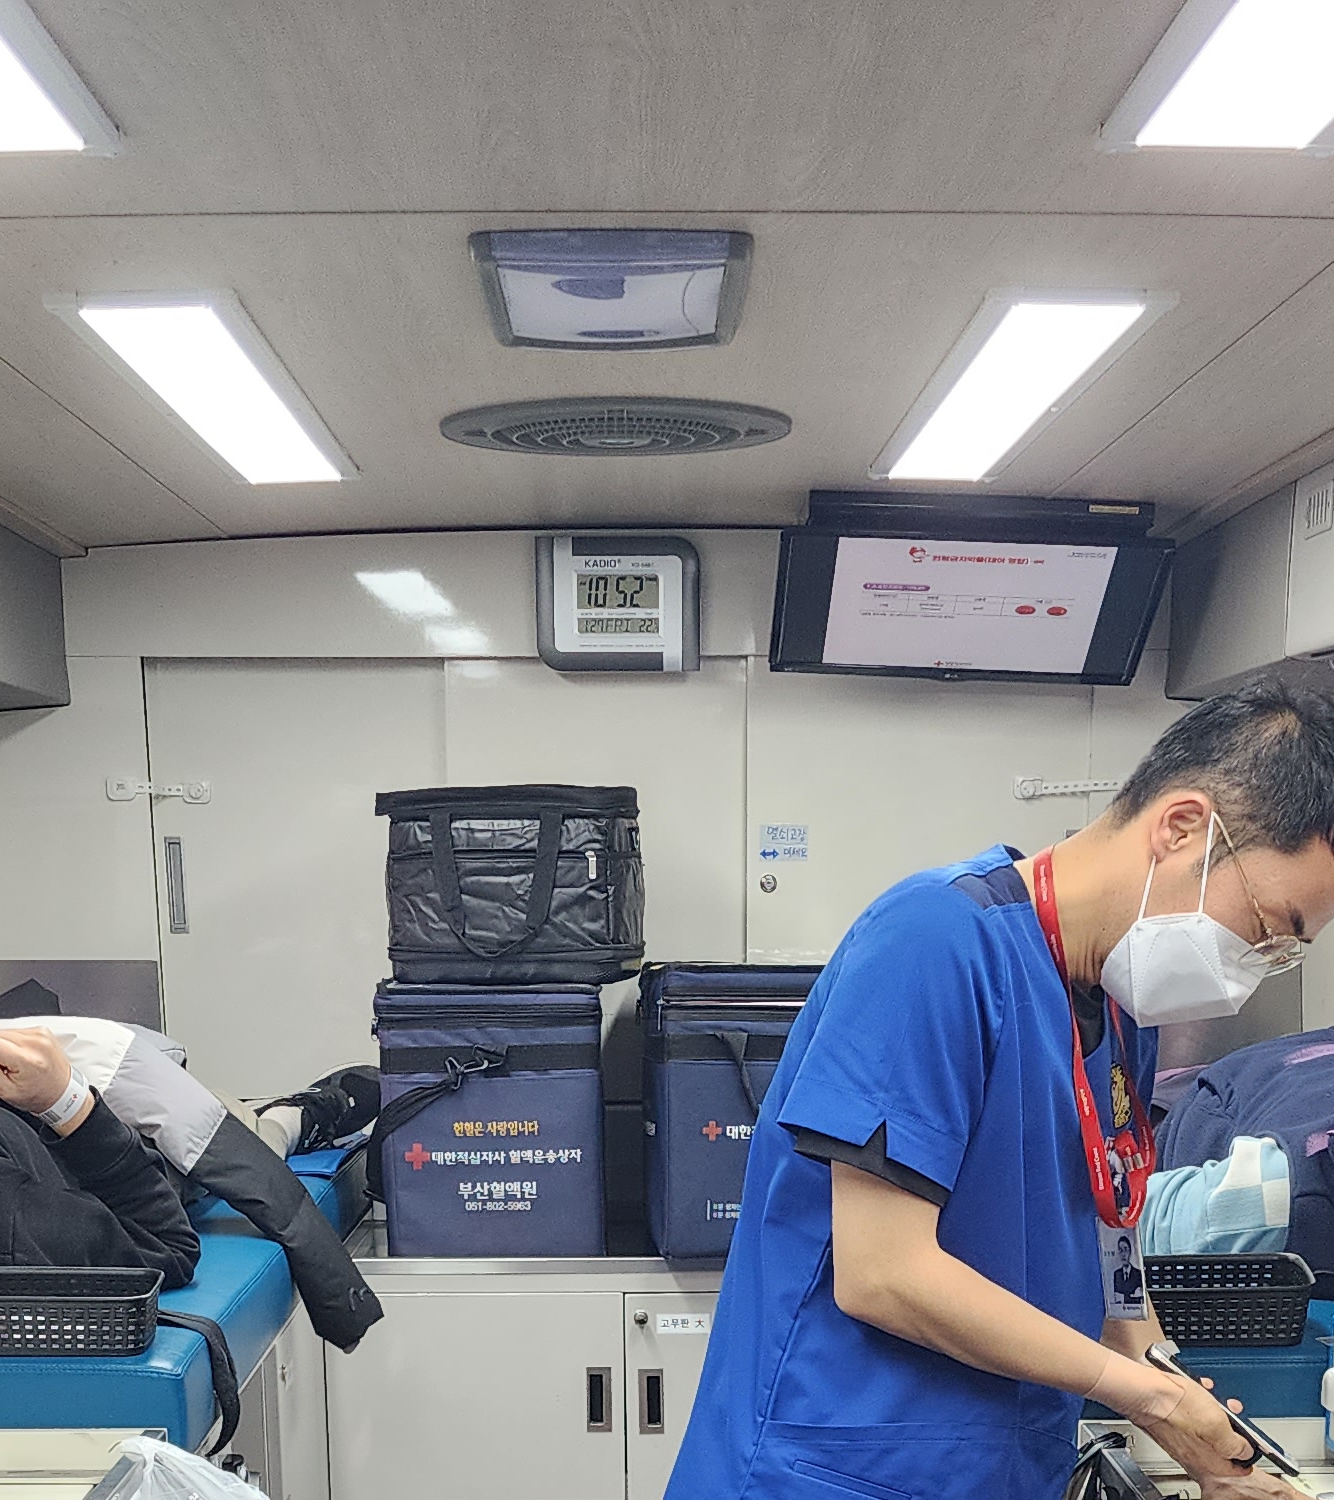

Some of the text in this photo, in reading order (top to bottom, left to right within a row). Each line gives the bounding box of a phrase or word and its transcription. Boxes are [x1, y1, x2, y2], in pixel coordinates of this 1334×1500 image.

[584, 559, 617, 568] KADIO
[487, 1121, 539, 1136] 사랑입니다
[726, 1124, 755, 1139] 대한
[432, 1149, 582, 1165] 대한적십자사 혈액운송상자
[458, 1181, 538, 1200] 부산혈액원
[465, 1201, 532, 1211] 051-802-5963
[661, 1318, 689, 1329] 고무판
